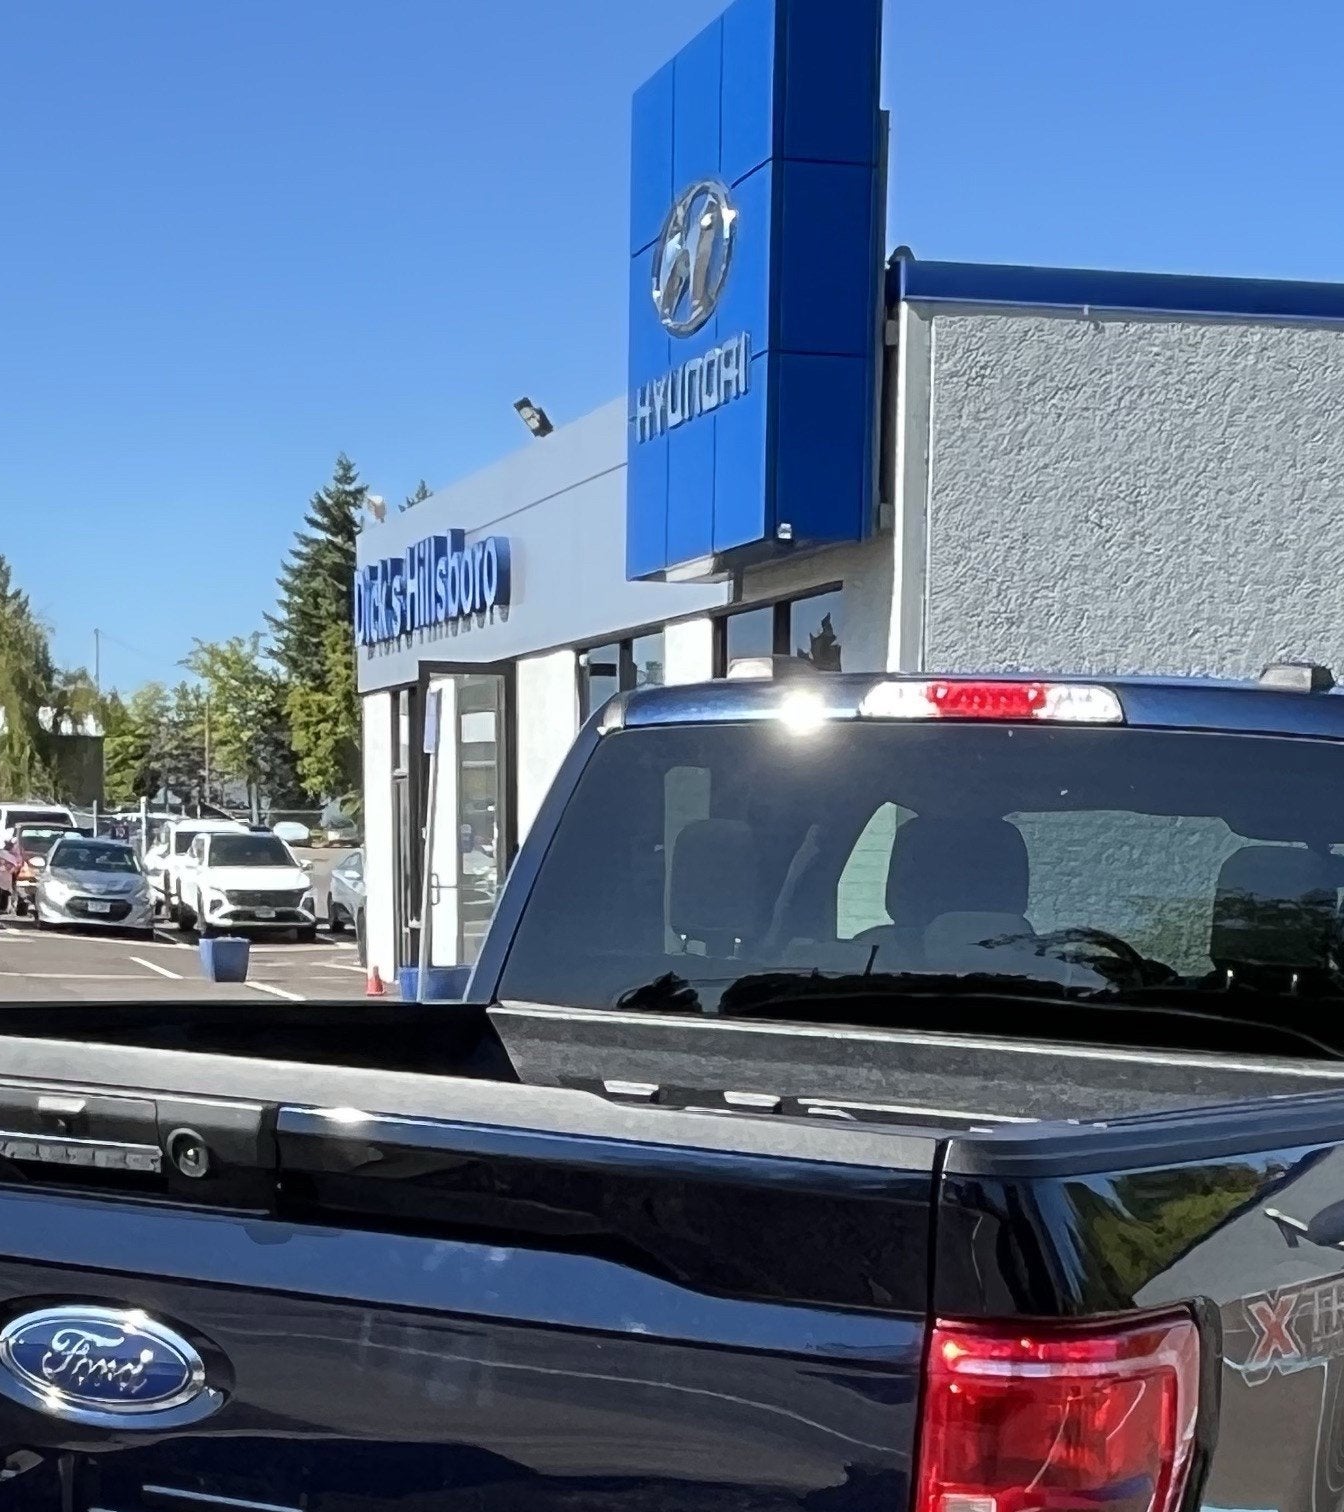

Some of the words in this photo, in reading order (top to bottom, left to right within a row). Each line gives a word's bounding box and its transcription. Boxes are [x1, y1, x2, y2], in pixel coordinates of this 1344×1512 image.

[637, 330, 751, 444] HYUNDAI
[354, 558, 404, 646] Dick's
[406, 528, 511, 632] Hillsboro
[42, 1328, 154, 1394] Ford
